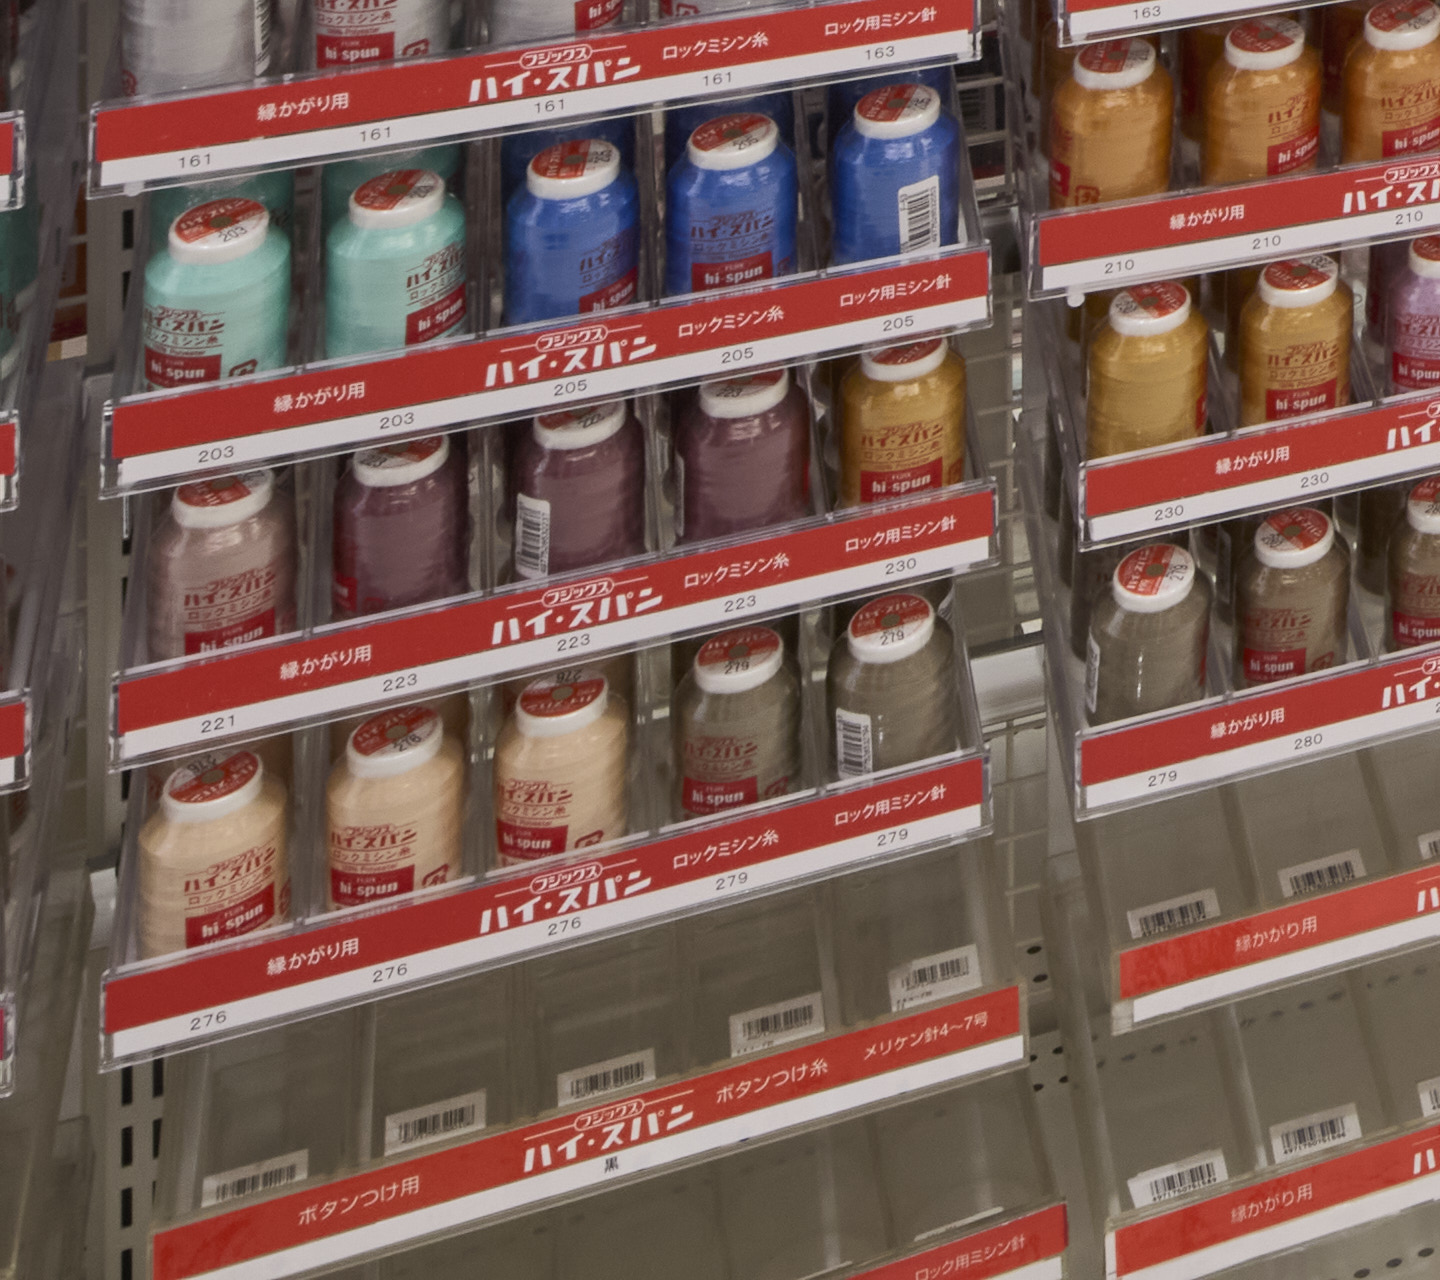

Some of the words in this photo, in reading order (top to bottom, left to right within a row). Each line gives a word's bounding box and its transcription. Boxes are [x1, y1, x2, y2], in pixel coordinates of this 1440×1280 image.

[190, 1011, 226, 1031] 276
[373, 963, 407, 983] 276
[716, 872, 747, 890] 279
[878, 829, 908, 846] 279
[267, 938, 358, 975] 縁かがり用
[481, 869, 651, 933] ハイ・スパン
[674, 830, 778, 869] ロックミシン糸
[835, 785, 946, 825] ロック用ミシン針
[1236, 916, 1317, 951] 縁かがり用
[300, 1176, 419, 1224] ボタンつけ用
[524, 1102, 693, 1175] ハイ・スパン
[717, 1059, 827, 1102] ボタンつけ糸
[605, 1157, 618, 1172] 黒
